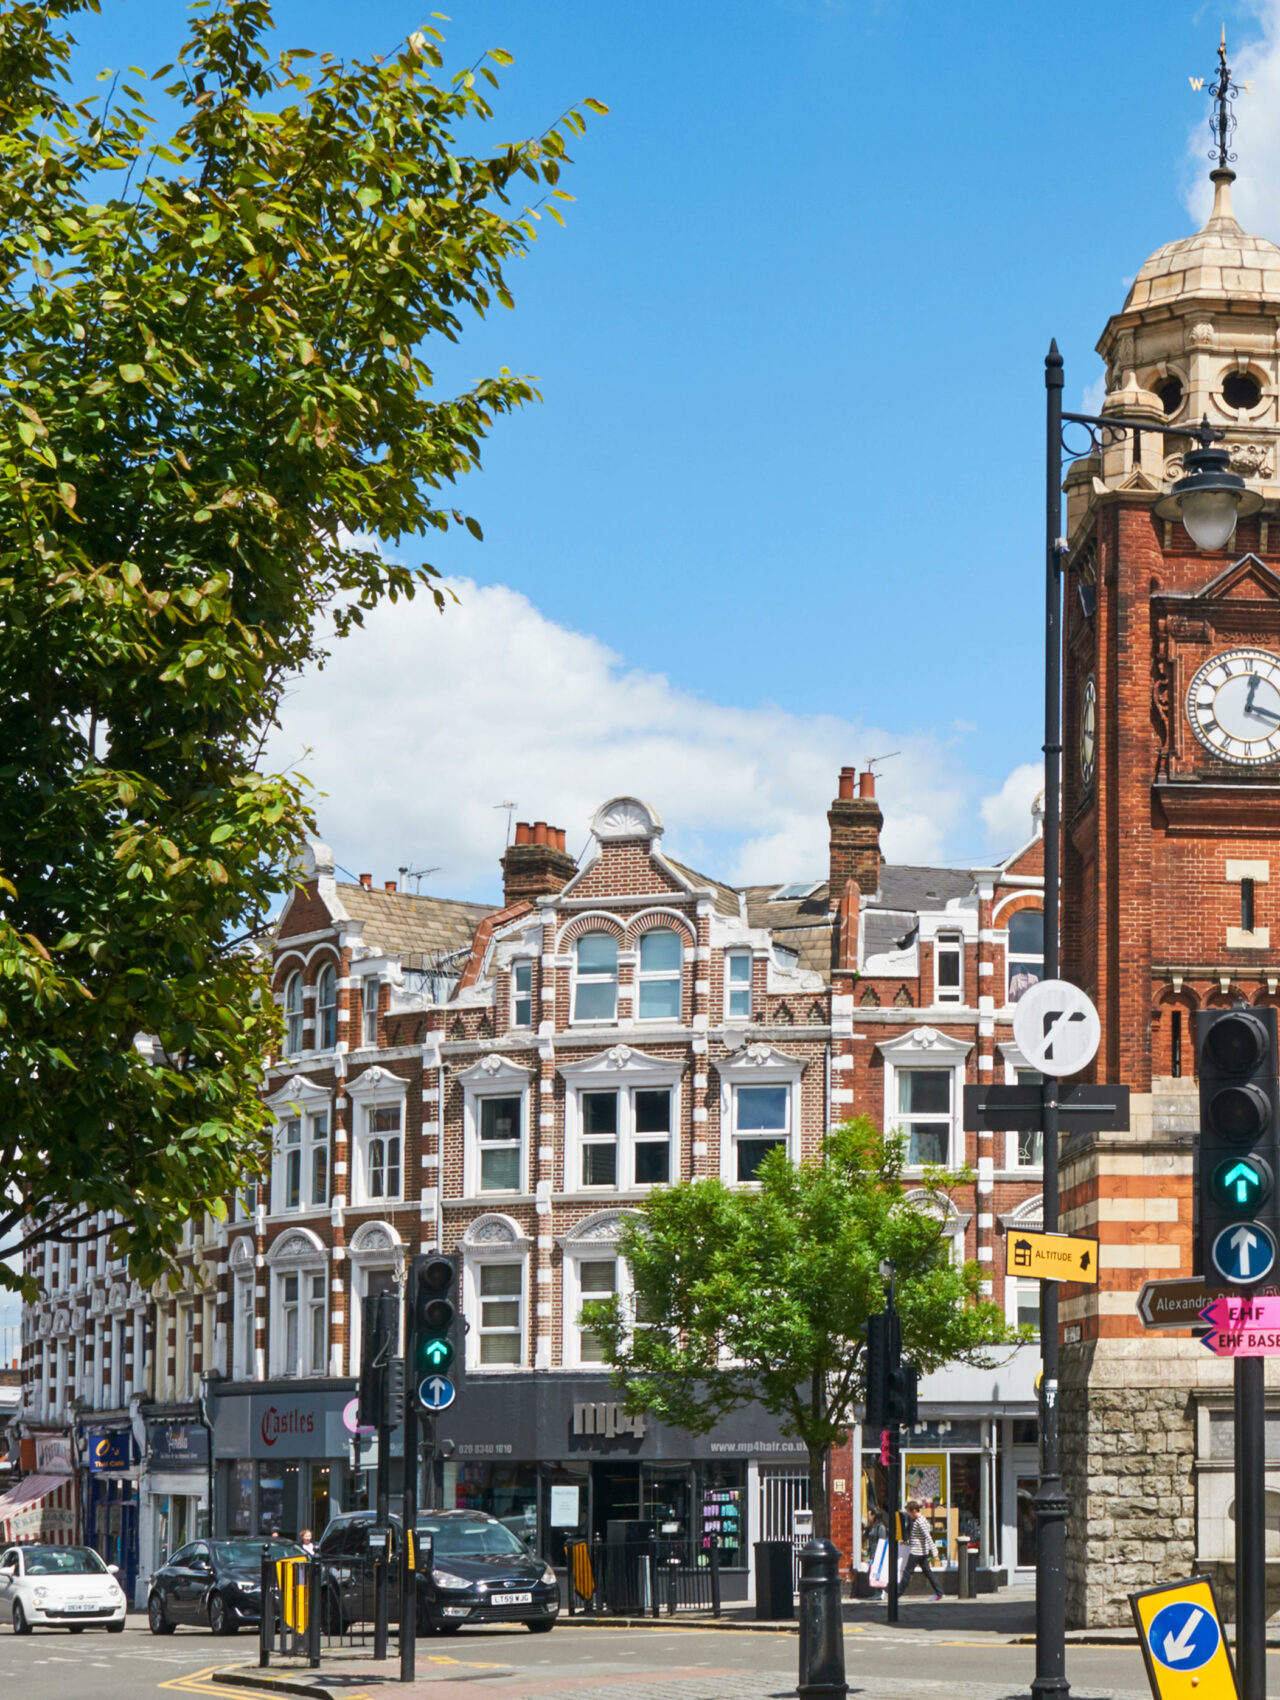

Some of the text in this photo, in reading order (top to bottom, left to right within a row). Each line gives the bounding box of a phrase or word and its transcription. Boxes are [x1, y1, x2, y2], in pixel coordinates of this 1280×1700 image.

[1188, 76, 1205, 92] W
[1243, 80, 1257, 95] E
[1035, 1250, 1072, 1262] ALTITUDE
[1156, 1296, 1214, 1311] Alexandra
[1229, 1307, 1265, 1321] EHF
[1218, 1334, 1244, 1347] EHF
[261, 1405, 314, 1446] Castles
[573, 1402, 647, 1438] mp4
[710, 1441, 809, 1453] www.mp4hair.co.uk
